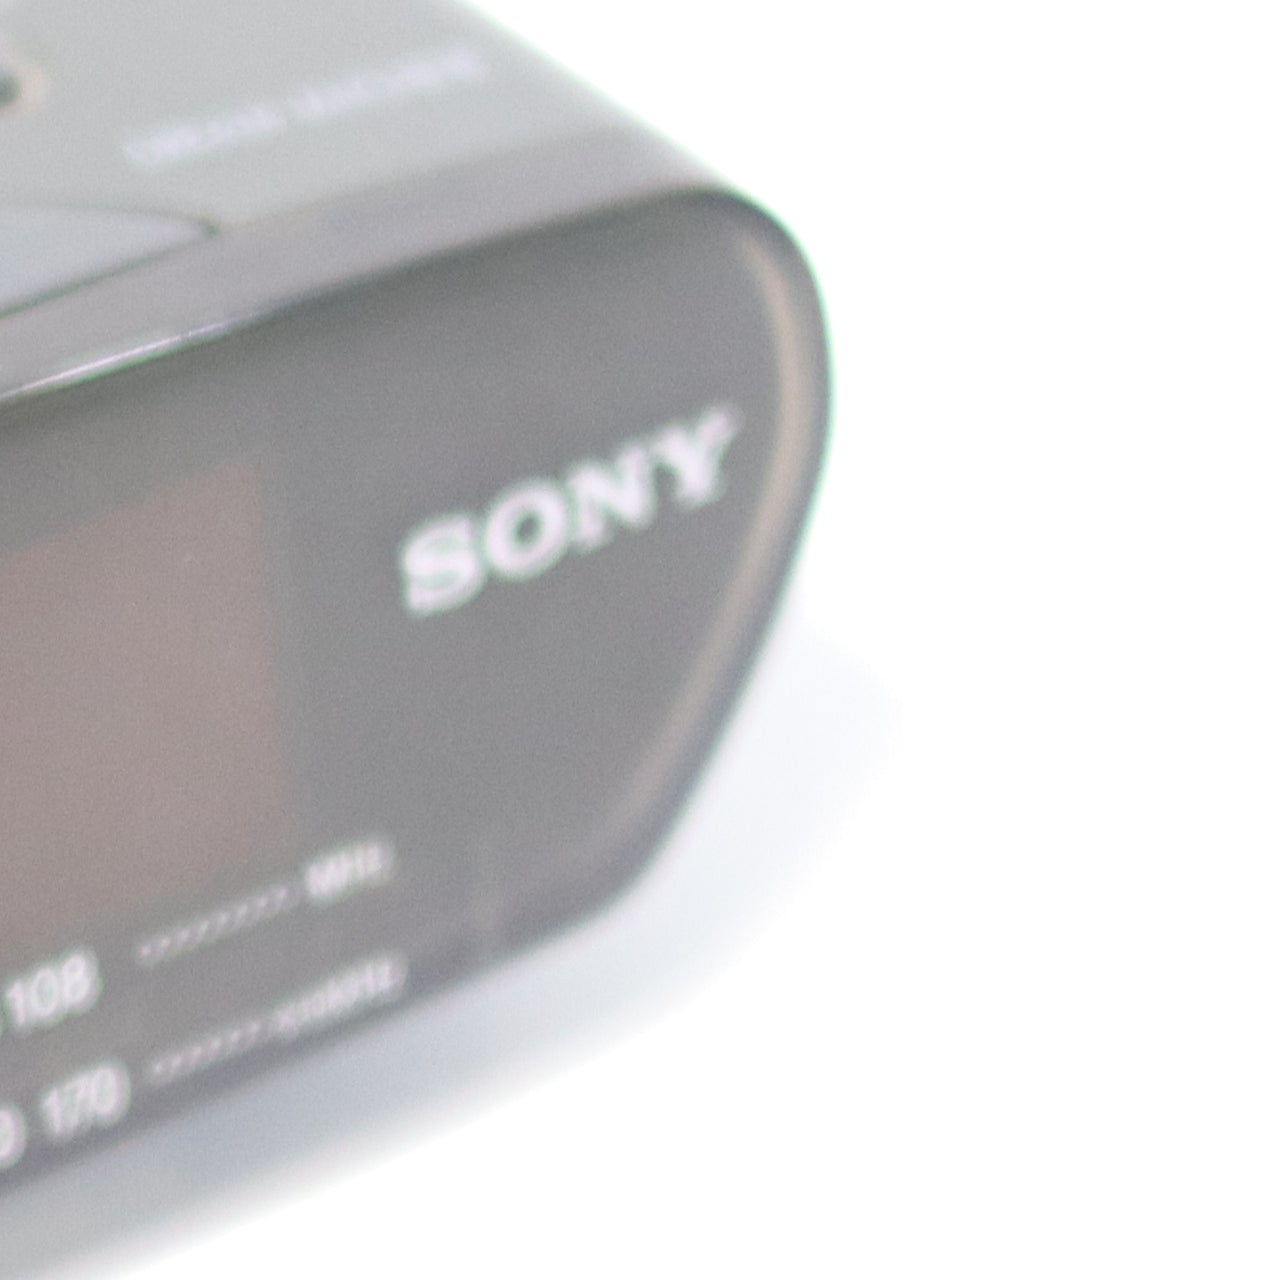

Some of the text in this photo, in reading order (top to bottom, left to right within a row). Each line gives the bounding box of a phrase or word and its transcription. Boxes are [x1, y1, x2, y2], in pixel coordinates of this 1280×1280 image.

[401, 403, 737, 617] SONY
[4, 948, 103, 1030] 108
[38, 1058, 131, 1141] 170
